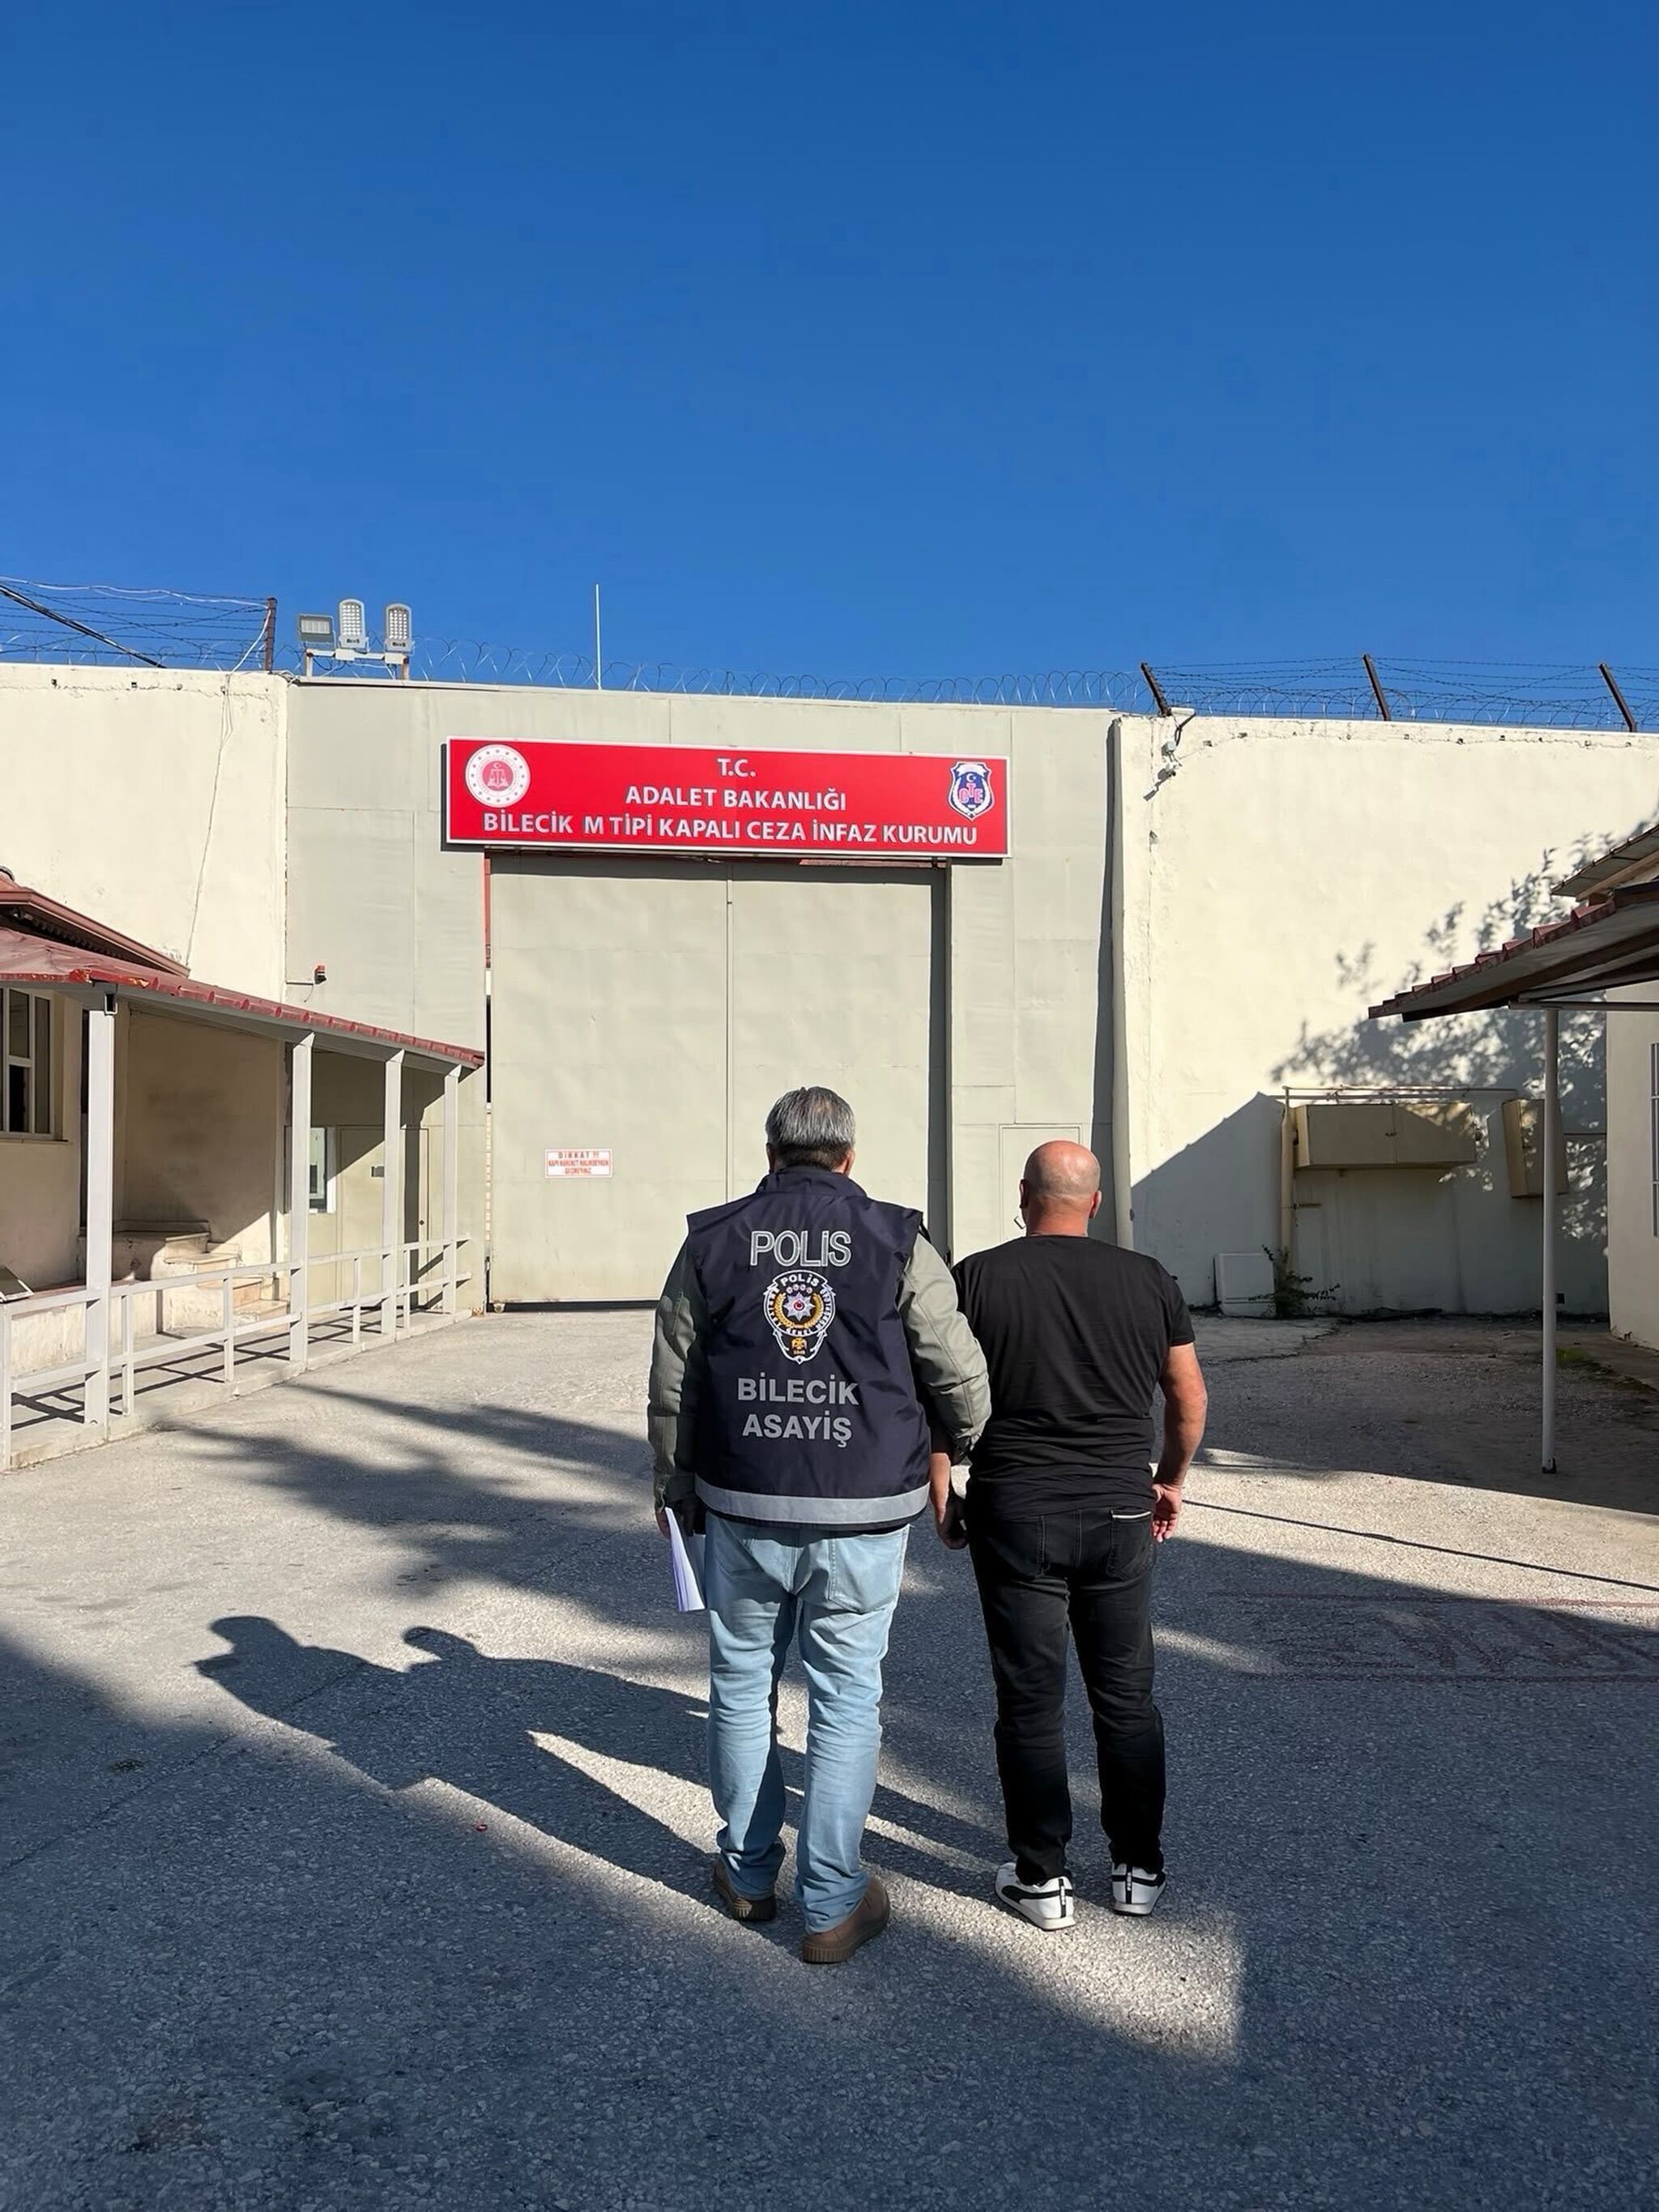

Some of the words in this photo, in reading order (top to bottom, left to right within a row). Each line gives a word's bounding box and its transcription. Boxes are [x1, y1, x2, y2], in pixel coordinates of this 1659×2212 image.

[717, 757, 757, 778] T.C.
[625, 785, 718, 808] ADALET
[723, 786, 847, 811] BAKANLIĞI
[484, 809, 574, 834] BİLECİK
[584, 815, 604, 835] M
[609, 813, 652, 837] TİPİ
[659, 817, 740, 839] KAPALI
[746, 820, 807, 842] CEZA
[812, 819, 877, 843] İNFAZ
[883, 824, 977, 846] KURUMU
[738, 1372, 859, 1405] BİLECİK
[742, 1410, 852, 1448] ASAYİŞ
